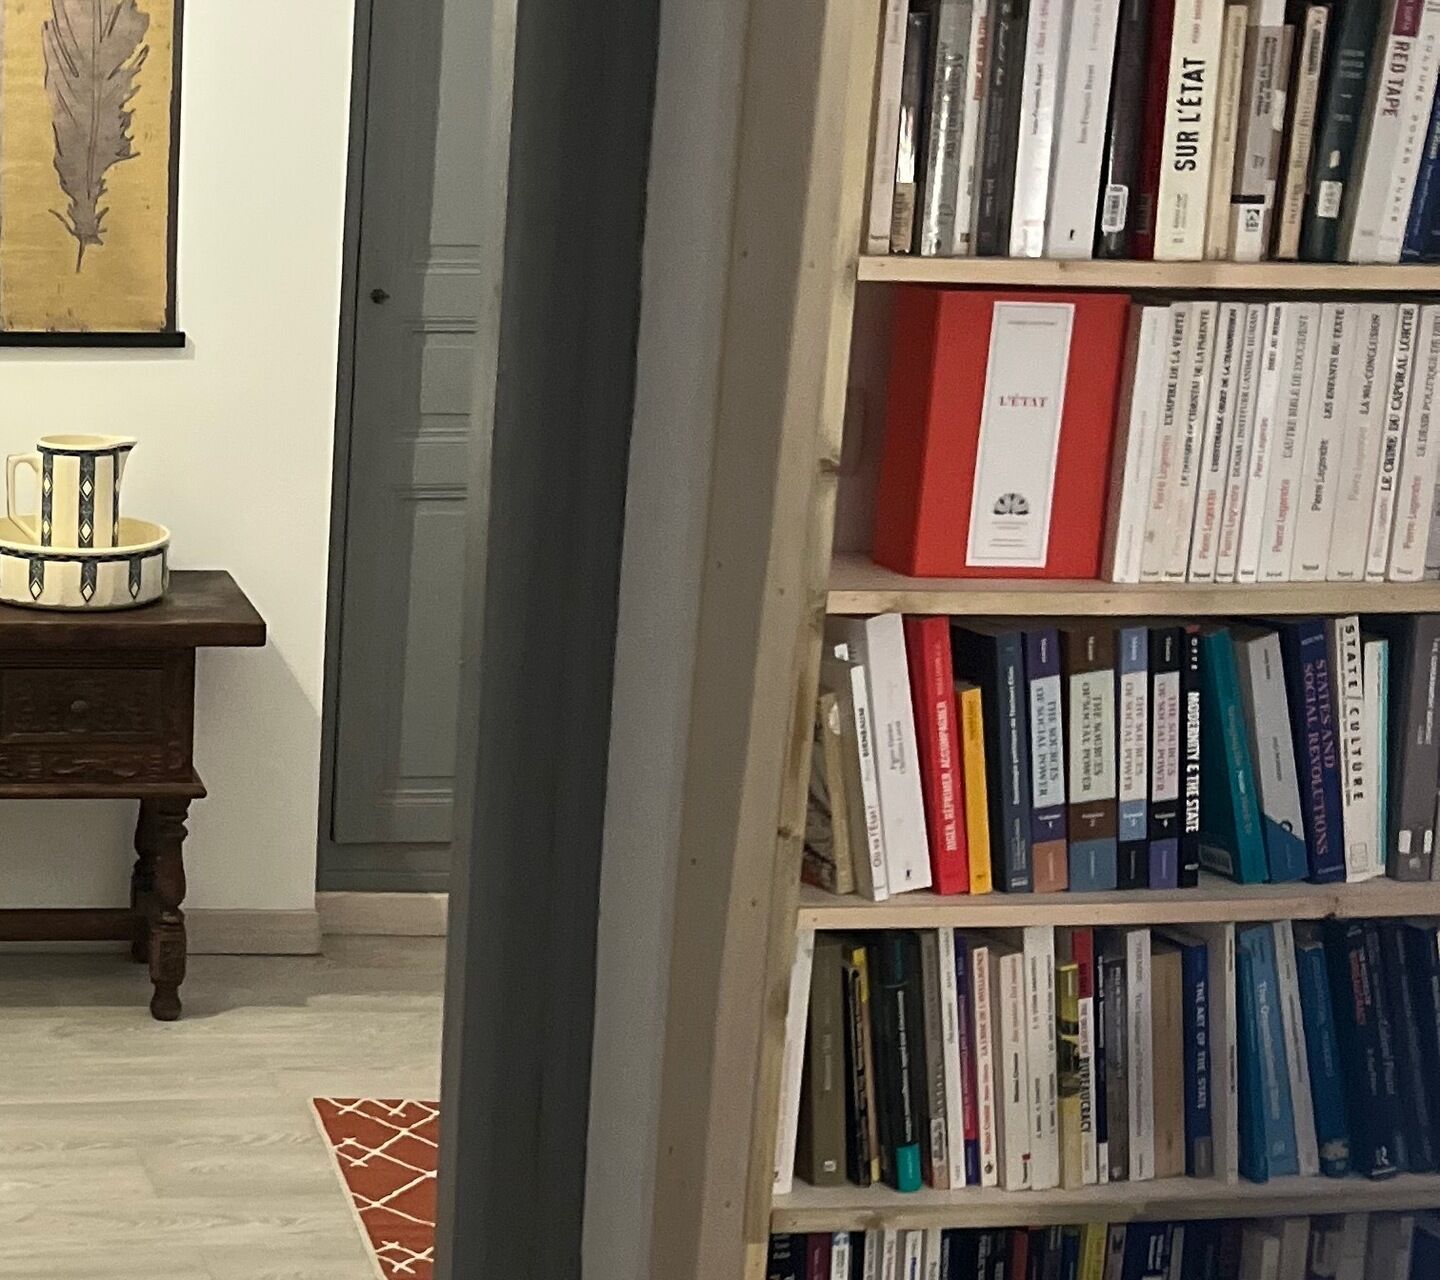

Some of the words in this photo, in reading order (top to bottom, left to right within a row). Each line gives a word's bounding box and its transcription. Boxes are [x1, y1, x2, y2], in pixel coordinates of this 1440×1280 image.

[1391, 40, 1411, 74] RED
[1175, 57, 1206, 122] L'ÉTAT
[1382, 78, 1405, 117] TAPE
[1173, 131, 1199, 171] SUR
[999, 394, 1049, 407] L'ÉTAT
[1391, 354, 1408, 411] CAPORAL
[1388, 414, 1400, 431] DU
[1380, 477, 1393, 491] LE
[1047, 700, 1057, 721] THE
[1092, 696, 1103, 718] THE
[1135, 695, 1145, 716] THE
[1167, 695, 1177, 717] THE
[1303, 661, 1317, 729] SOCIAL
[1315, 659, 1332, 725] STATES
[1037, 705, 1047, 747] SOCIAL
[1081, 700, 1092, 744] SOCIAL
[1123, 700, 1134, 744] SOCIAL
[1156, 700, 1166, 745] SOCIAL
[1186, 691, 1200, 761] MODERNITY
[1049, 727, 1059, 781] SOURCES
[1092, 721, 1103, 776] SOURCES
[1135, 721, 1145, 775] SOURCES
[1166, 721, 1177, 776] SOURCES
[1322, 729, 1335, 769] AND
[1038, 751, 1049, 796] POWER
[1081, 748, 1092, 792] POWER
[1123, 748, 1134, 791] POWER
[1156, 748, 1166, 792] POWER
[1186, 774, 1199, 798] THE
[1307, 732, 1328, 855] REVOLUTIONS
[1185, 799, 1199, 833] STATE
[1195, 980, 1205, 1003] THE
[1196, 1005, 1205, 1027] ART
[1196, 1031, 1205, 1046] OF
[1196, 1050, 1206, 1073] THE
[1078, 1056, 1091, 1133] BUREAUCRACY
[1196, 1077, 1208, 1109] STATE
